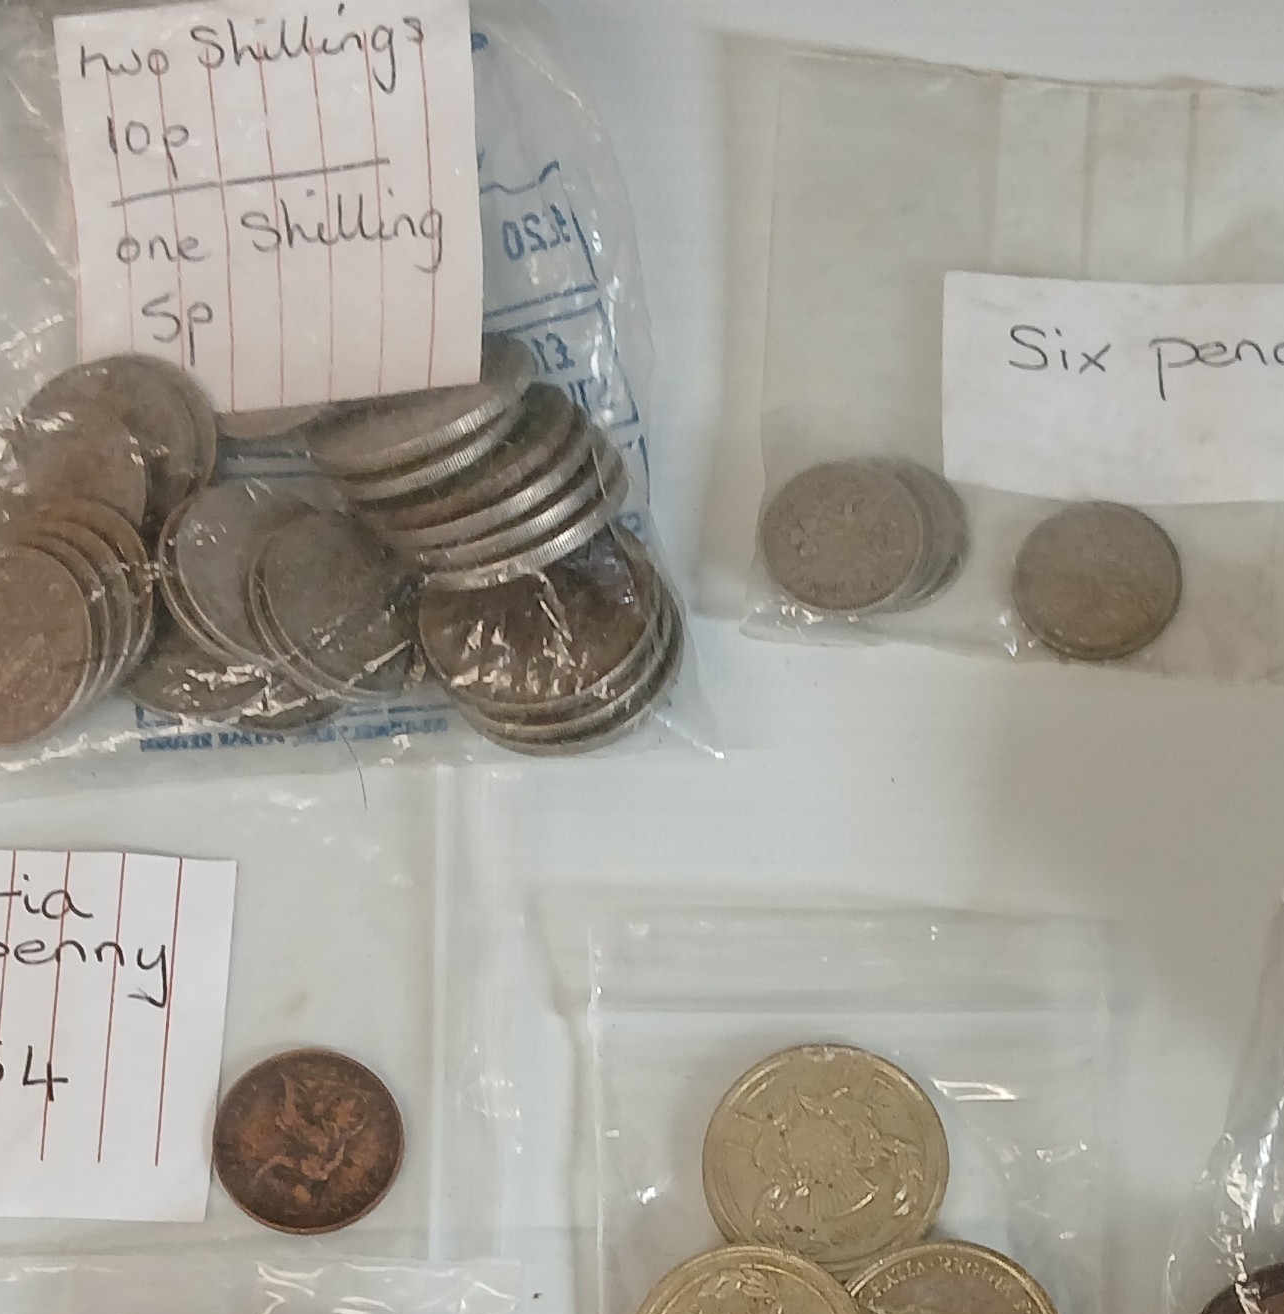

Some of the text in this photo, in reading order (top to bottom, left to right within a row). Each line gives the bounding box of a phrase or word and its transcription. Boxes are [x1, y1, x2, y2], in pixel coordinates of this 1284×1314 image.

[79, 43, 170, 80] two
[106, 115, 189, 179] 10p
[116, 233, 206, 265] one
[1008, 325, 1111, 373] Six
